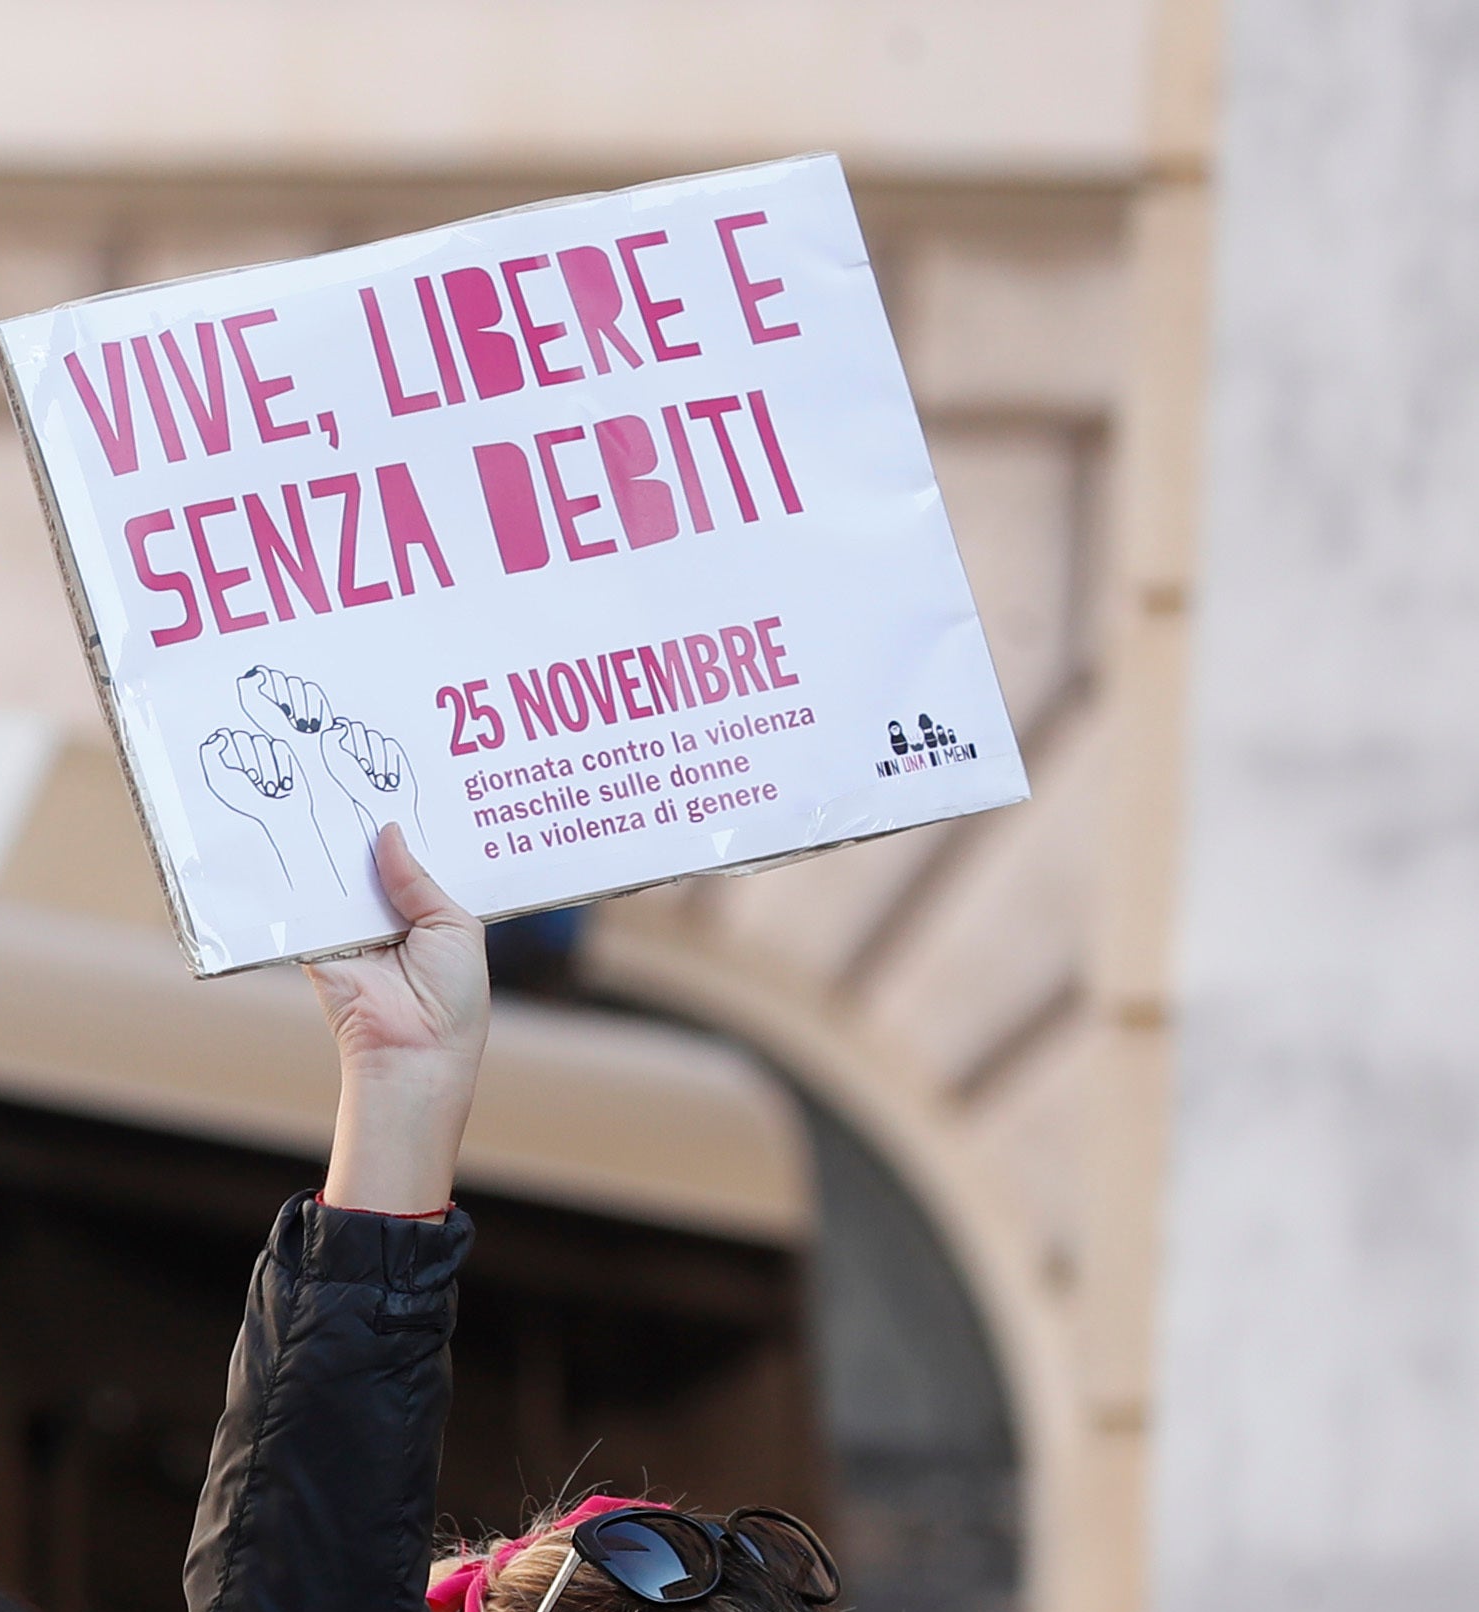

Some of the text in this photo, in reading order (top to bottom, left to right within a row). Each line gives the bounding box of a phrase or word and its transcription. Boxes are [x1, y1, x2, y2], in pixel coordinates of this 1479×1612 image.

[63, 210, 802, 476] VIVE, LIBERE E
[124, 389, 804, 647] SENZA DEBITI
[435, 616, 799, 756] 25 NOVEMBRE
[464, 707, 816, 801] giornata contro la violenza
[473, 755, 751, 828] maschile sulle donne
[902, 753, 928, 773] UNA
[483, 782, 779, 859] e la violenza di genere
